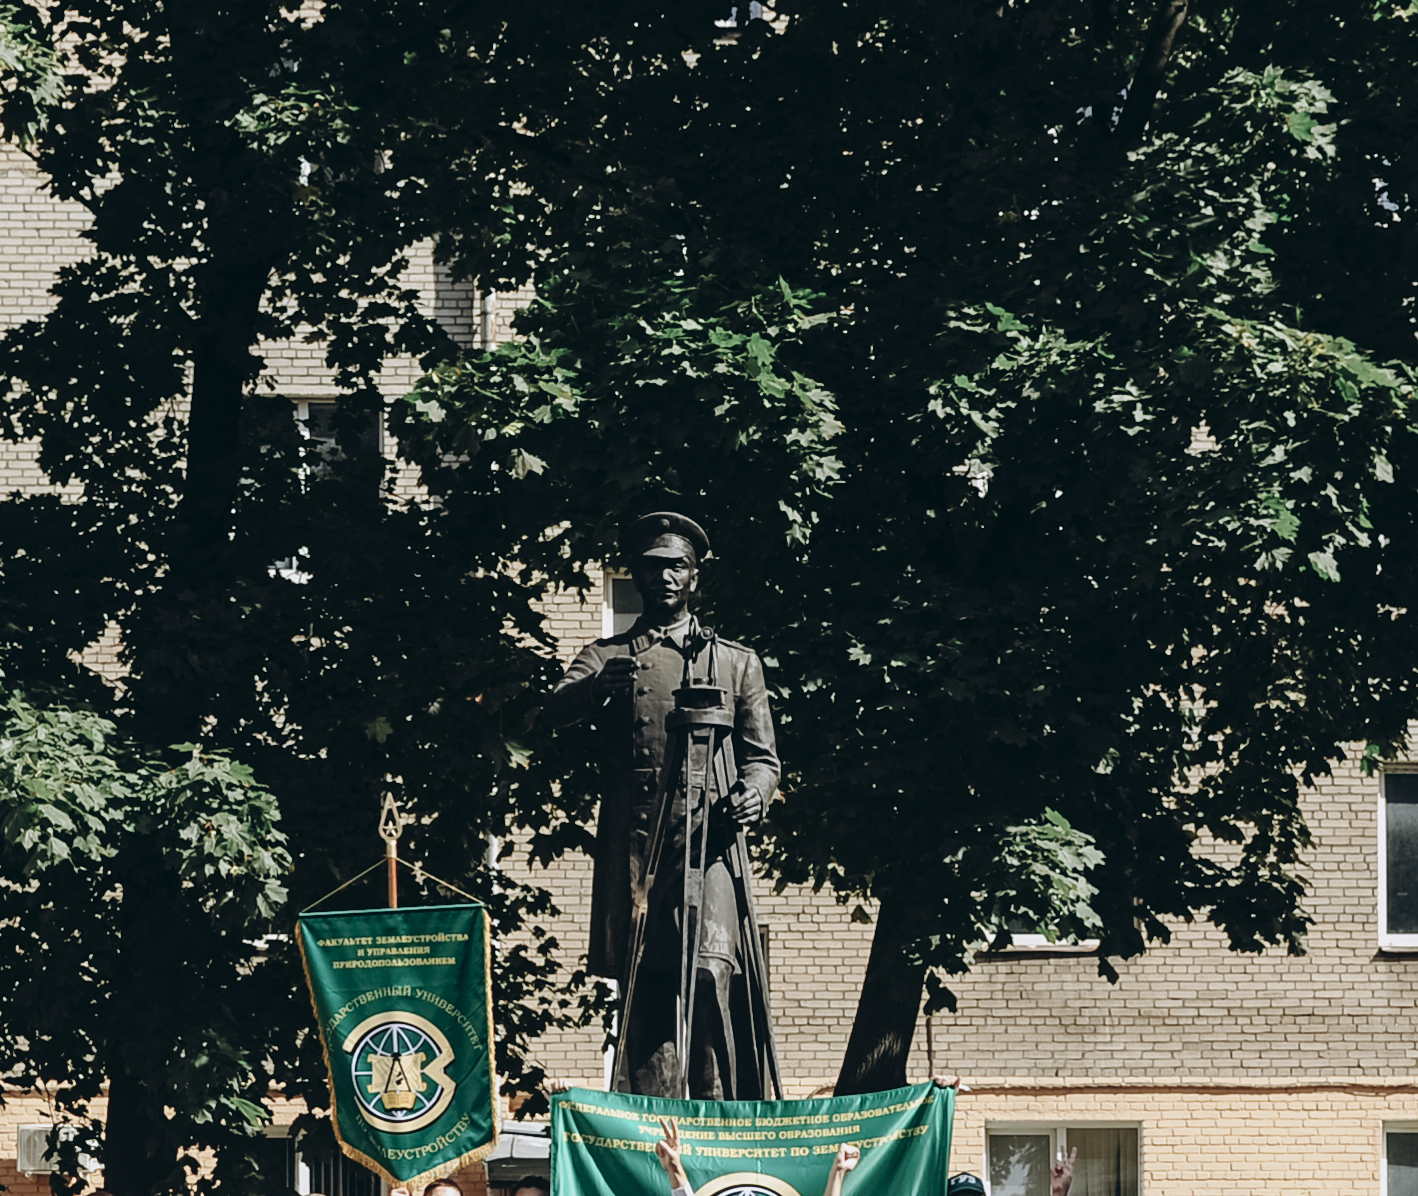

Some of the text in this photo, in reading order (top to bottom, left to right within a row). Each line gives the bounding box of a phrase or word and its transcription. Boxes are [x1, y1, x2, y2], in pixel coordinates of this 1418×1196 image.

[317, 932, 469, 948] ФАКУЛЬТЕТ ЗЕМЛЕУСТРОЙСТВА
[366, 946, 431, 957] УПРАВЛЕНИЯ
[415, 988, 483, 1050] УНИВЕРСИТЕТ
[755, 1114, 831, 1128] БЮДЖЕТНОЕ
[717, 1130, 777, 1141] ВЫСШЕГО
[778, 1124, 861, 1140] ОБРАЗОВАНИЯ
[695, 1145, 787, 1159] УНИВЕРСИТЕТ
[790, 1146, 810, 1157] ПО
